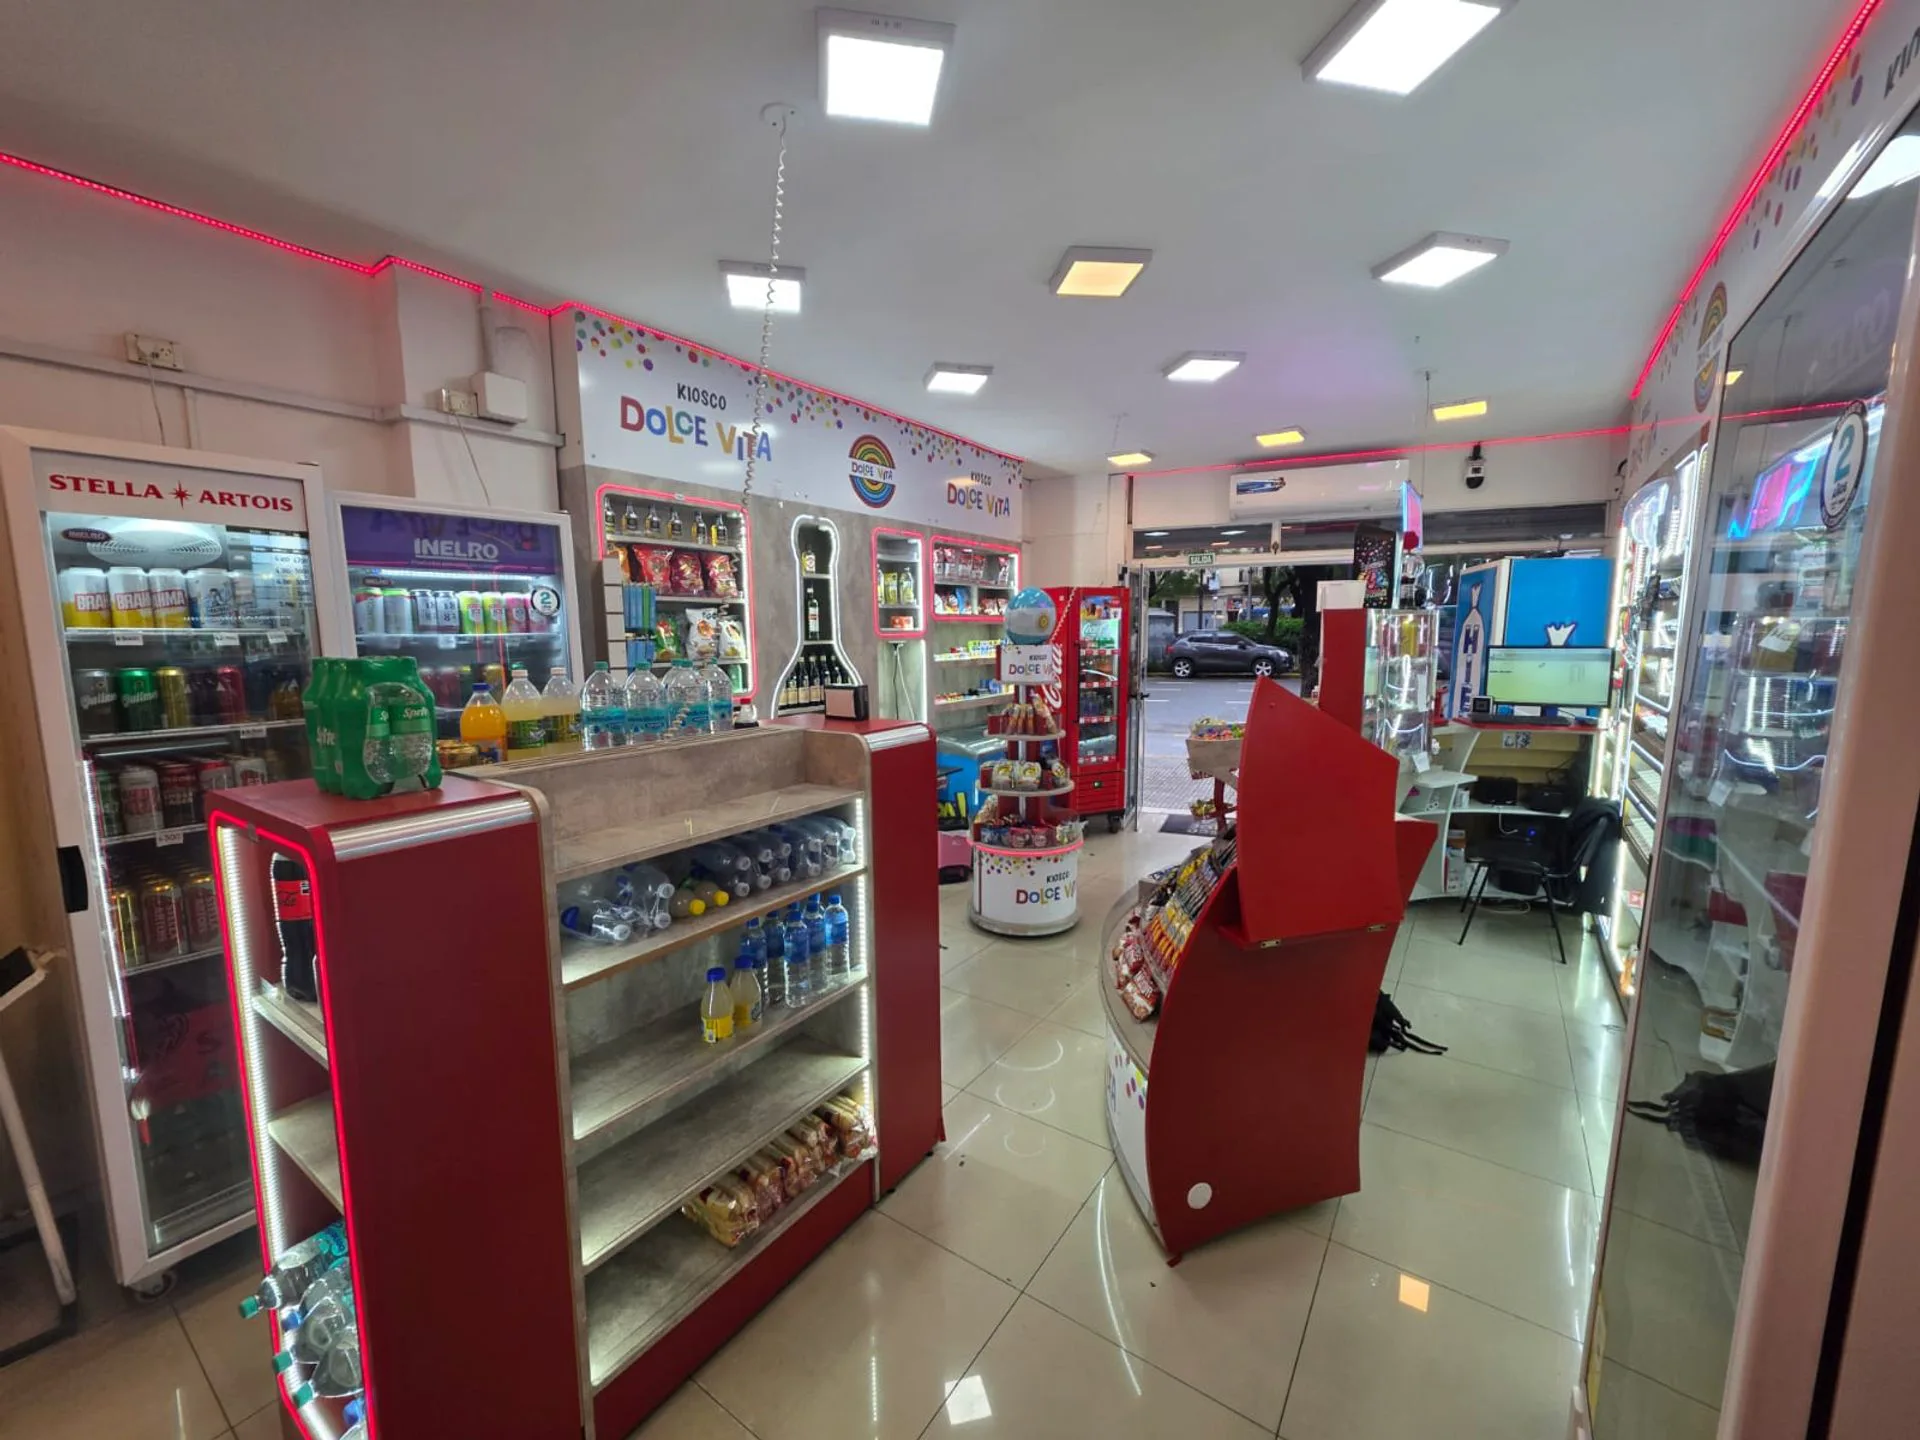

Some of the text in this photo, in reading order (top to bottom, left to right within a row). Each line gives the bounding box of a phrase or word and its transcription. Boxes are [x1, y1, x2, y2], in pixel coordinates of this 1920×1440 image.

[677, 383, 727, 410] KIOSCO
[620, 395, 772, 462] DOLCE VITA
[851, 461, 893, 481] DOLCE VITA
[970, 471, 992, 486] KIOSCO
[48, 474, 294, 512] STELLA ARTOIS
[947, 482, 1010, 517] DOLCE VITA
[413, 537, 498, 559] INELRO
[1190, 554, 1213, 565] SALIDA
[76, 592, 109, 611] BRA
[1008, 663, 1041, 676] DOLCE
[1016, 886, 1061, 905] DOLCE
